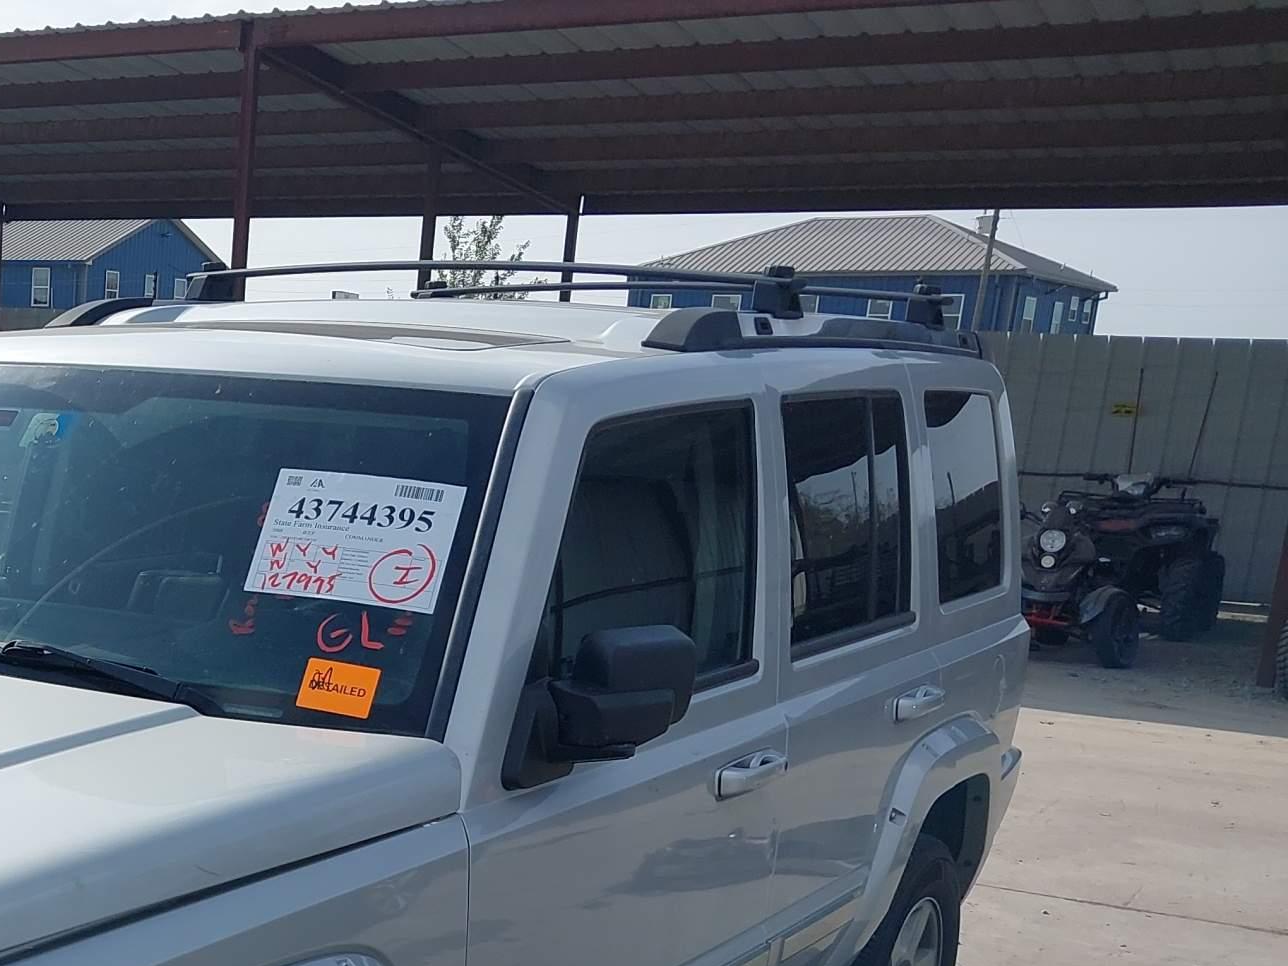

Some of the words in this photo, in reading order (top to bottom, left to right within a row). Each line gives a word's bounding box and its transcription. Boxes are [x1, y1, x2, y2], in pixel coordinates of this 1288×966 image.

[273, 518, 292, 528] State
[293, 521, 313, 529] Farm
[314, 521, 351, 532] Insurance
[288, 497, 435, 533] 43744395
